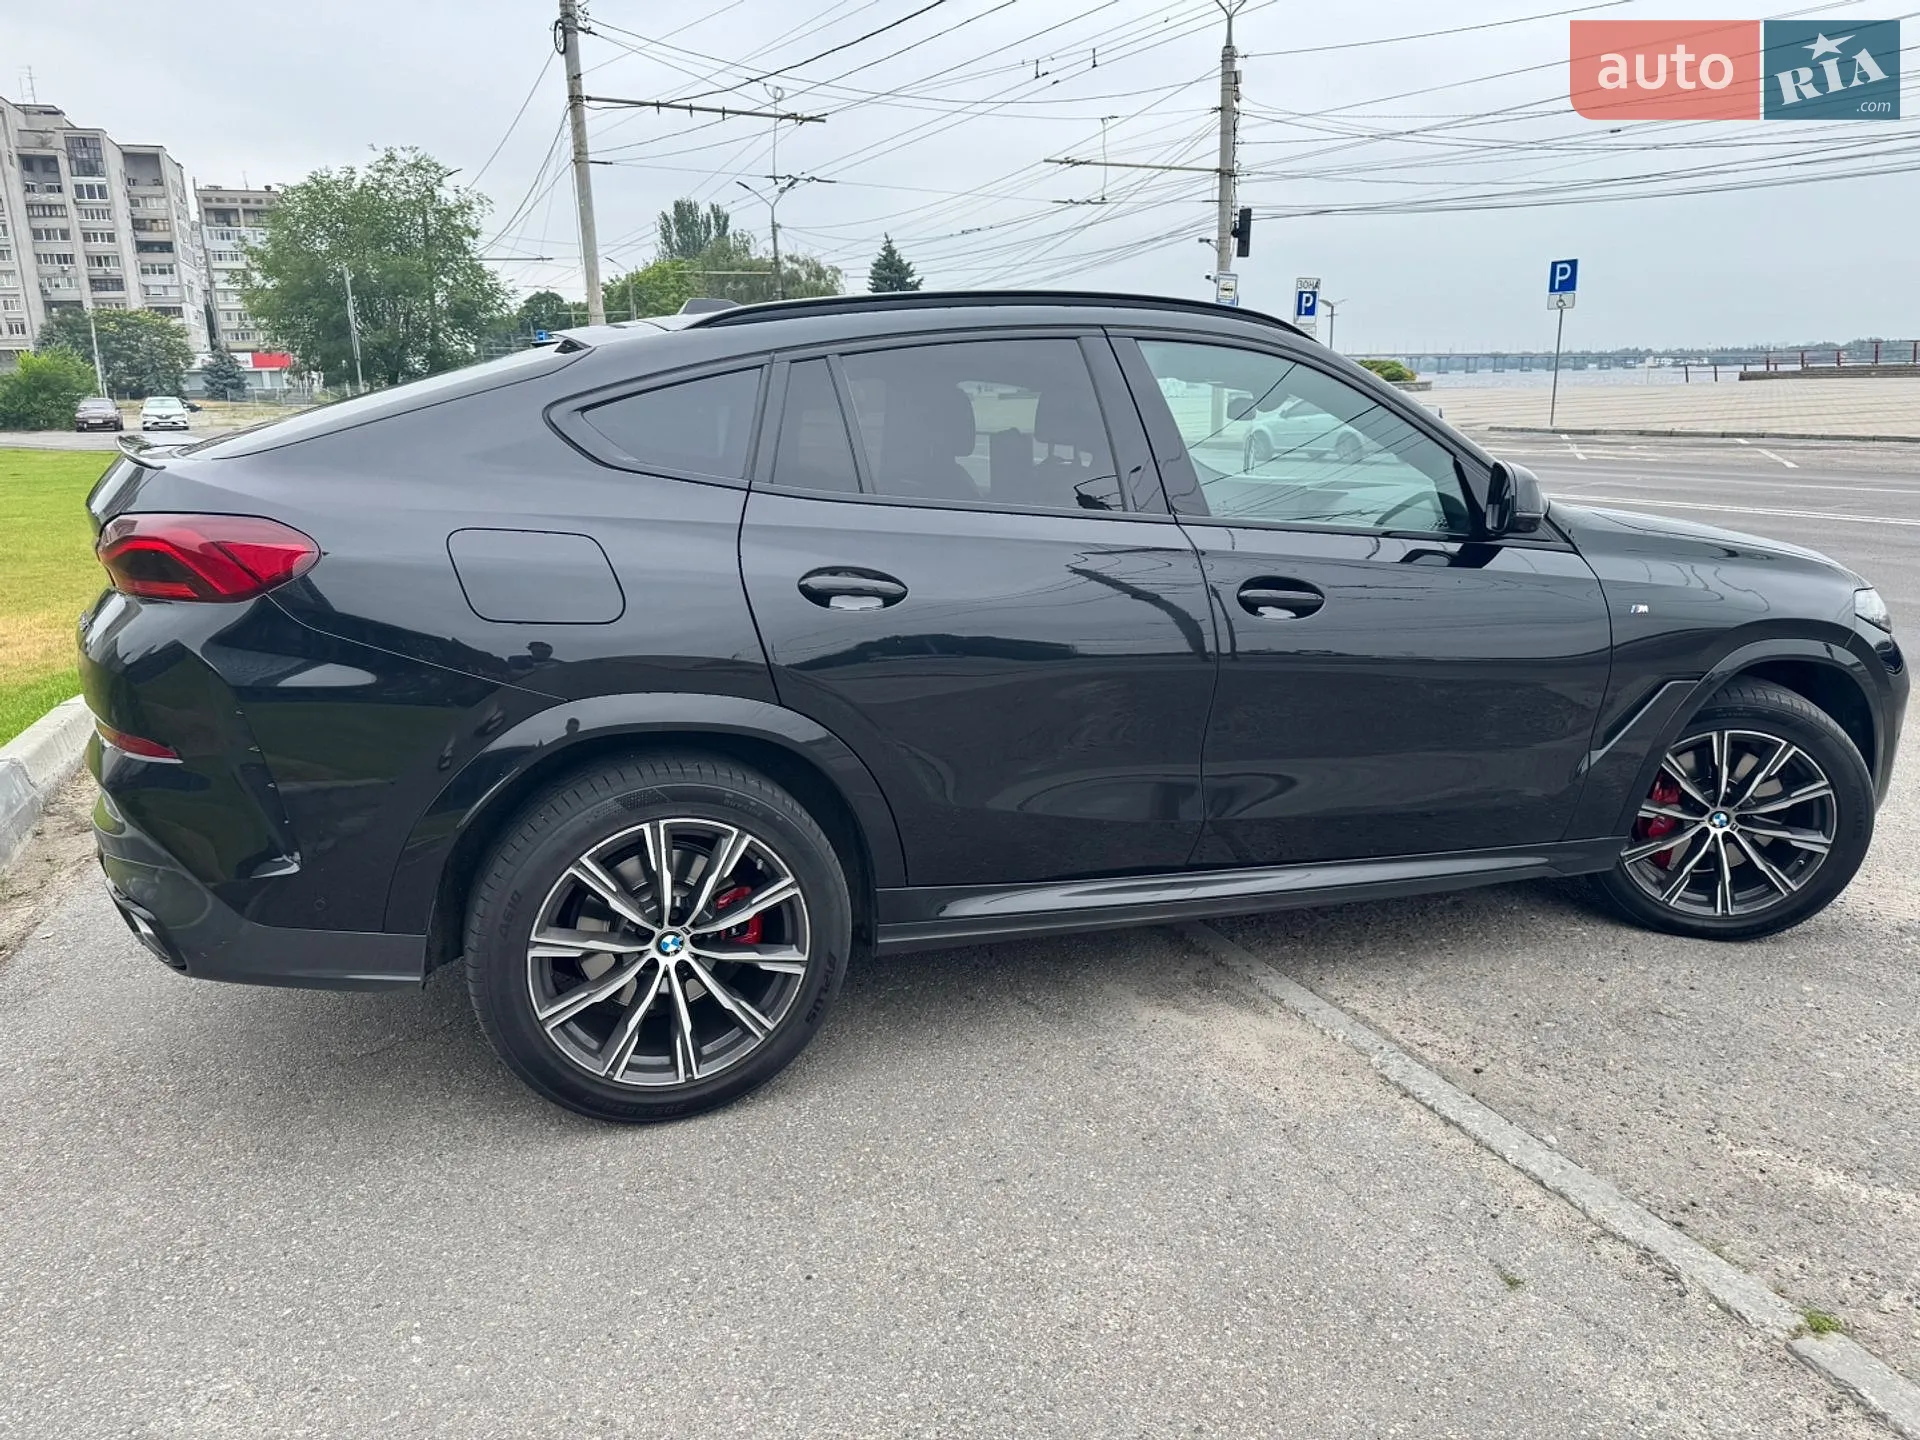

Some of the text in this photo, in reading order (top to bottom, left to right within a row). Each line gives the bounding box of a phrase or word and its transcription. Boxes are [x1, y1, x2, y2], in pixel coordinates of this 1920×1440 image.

[1297, 279, 1320, 290] ЗОНА
[1554, 262, 1572, 290] P
[1301, 292, 1314, 315] P
